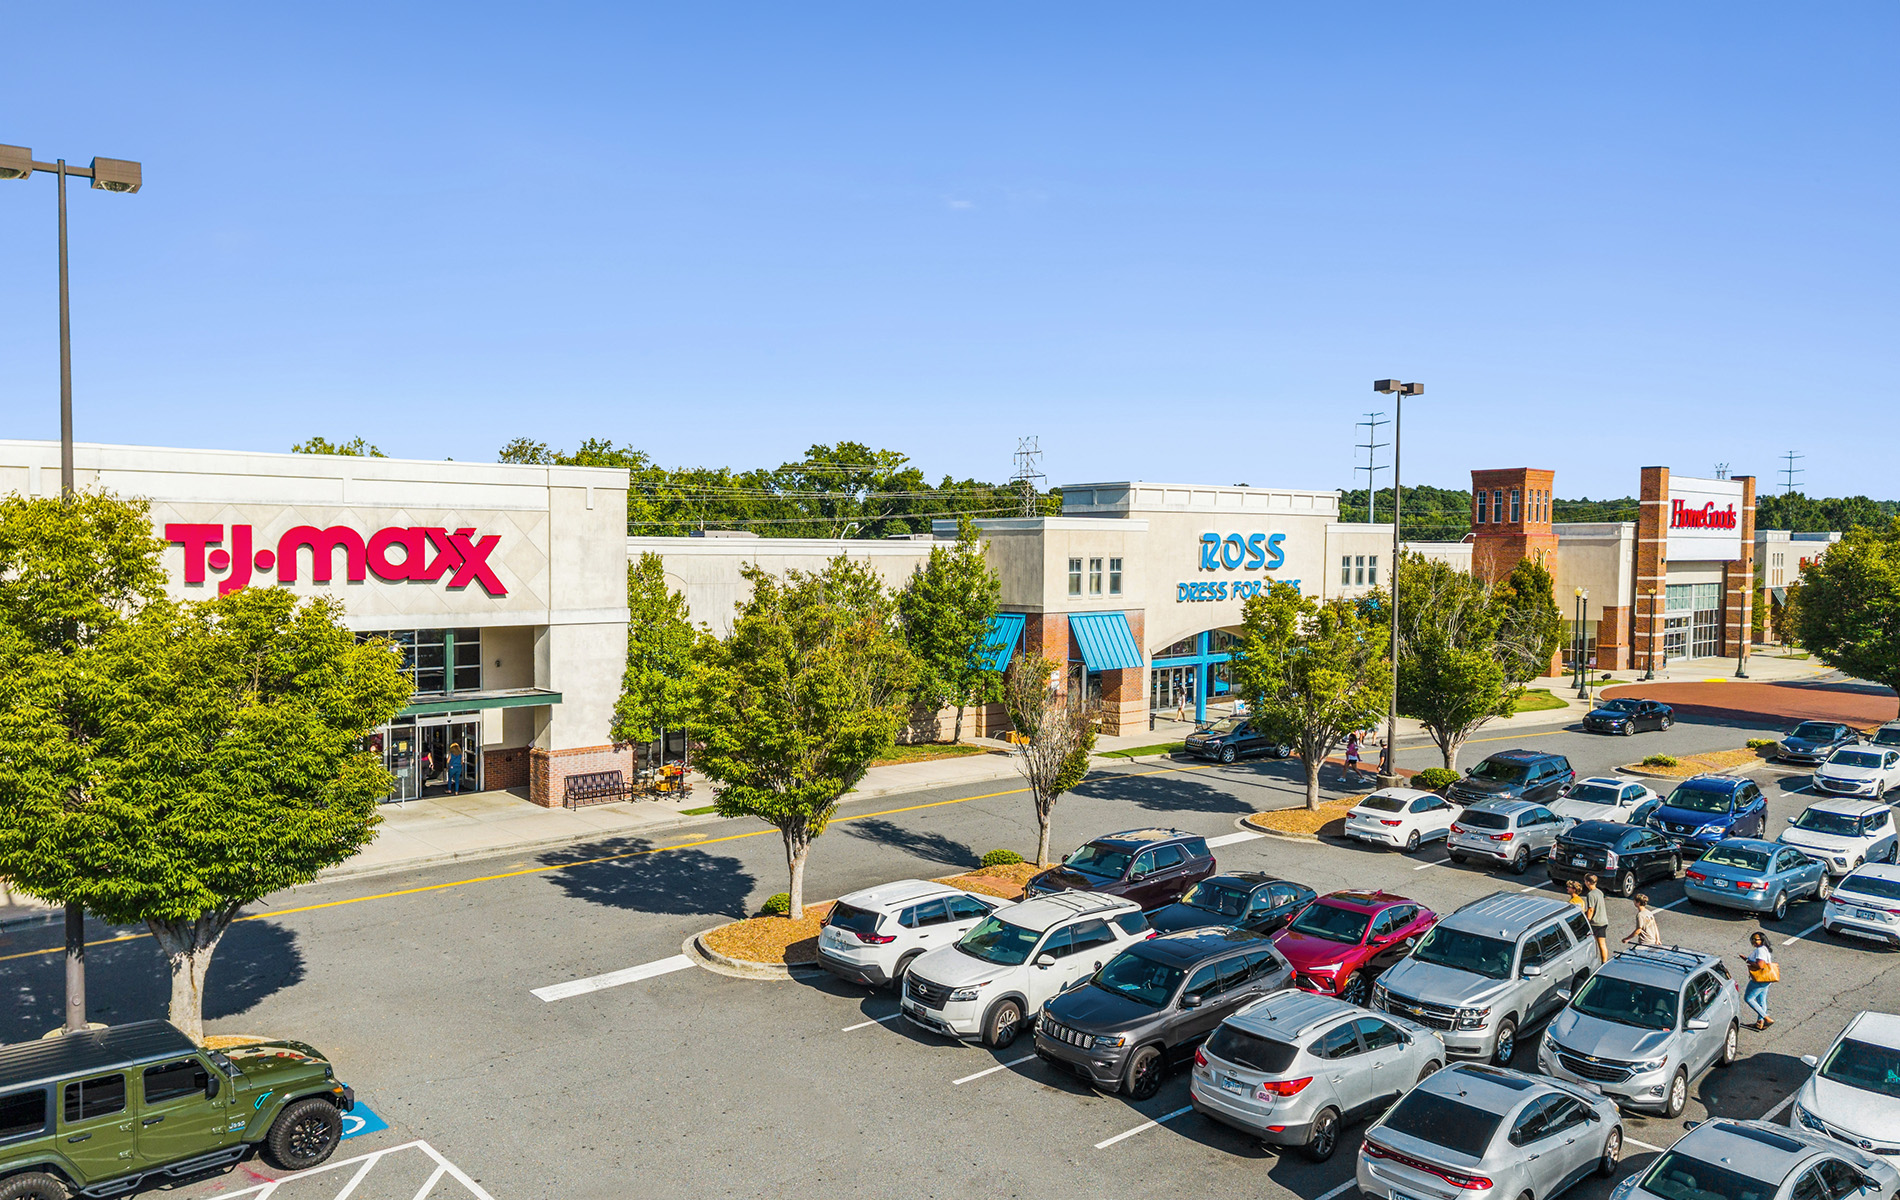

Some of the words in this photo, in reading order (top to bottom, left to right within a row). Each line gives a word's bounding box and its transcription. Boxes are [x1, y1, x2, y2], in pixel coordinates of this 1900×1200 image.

[1670, 499, 1737, 530] HomeGoods
[1200, 532, 1287, 570] ROSS
[1177, 581, 1228, 601] DRESS
[1232, 580, 1262, 599] FOR
